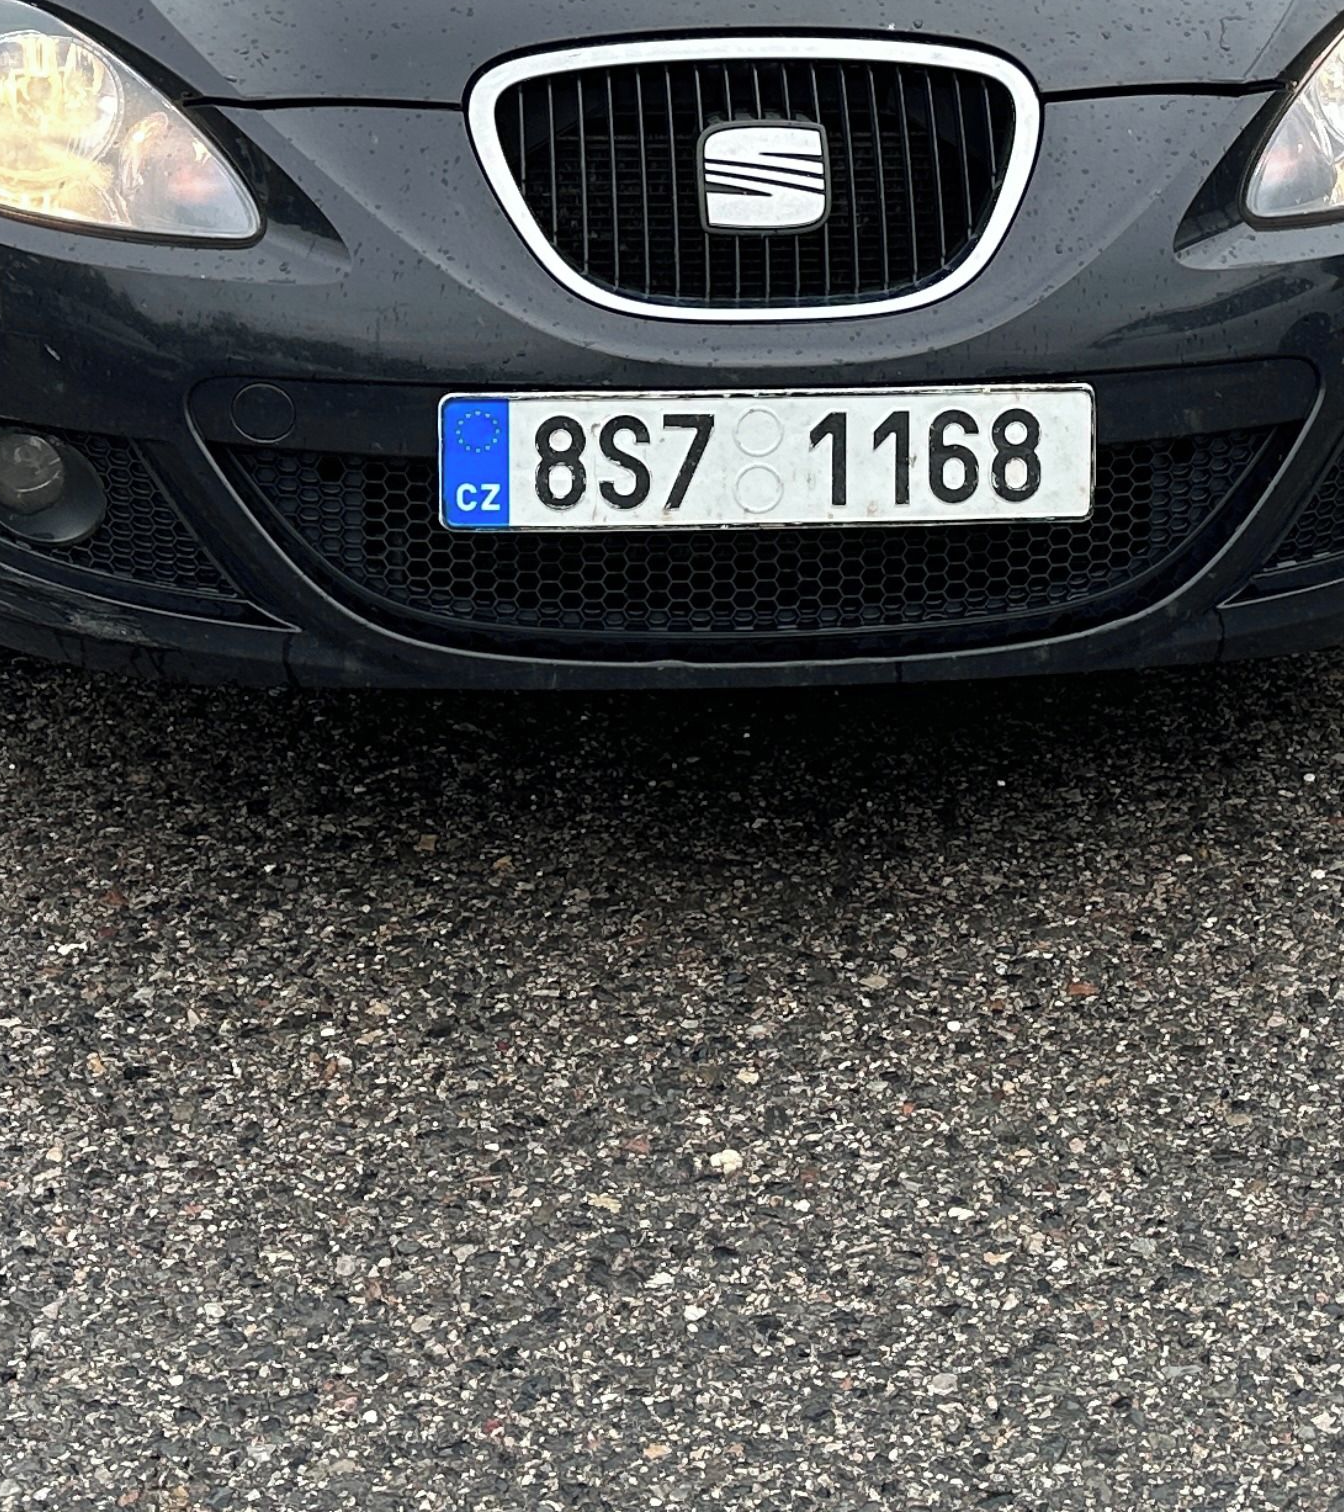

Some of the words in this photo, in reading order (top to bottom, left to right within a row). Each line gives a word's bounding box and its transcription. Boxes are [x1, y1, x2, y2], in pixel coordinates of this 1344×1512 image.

[534, 414, 715, 511] 8S7
[809, 407, 1041, 506] 1168
[456, 482, 501, 512] CZ
